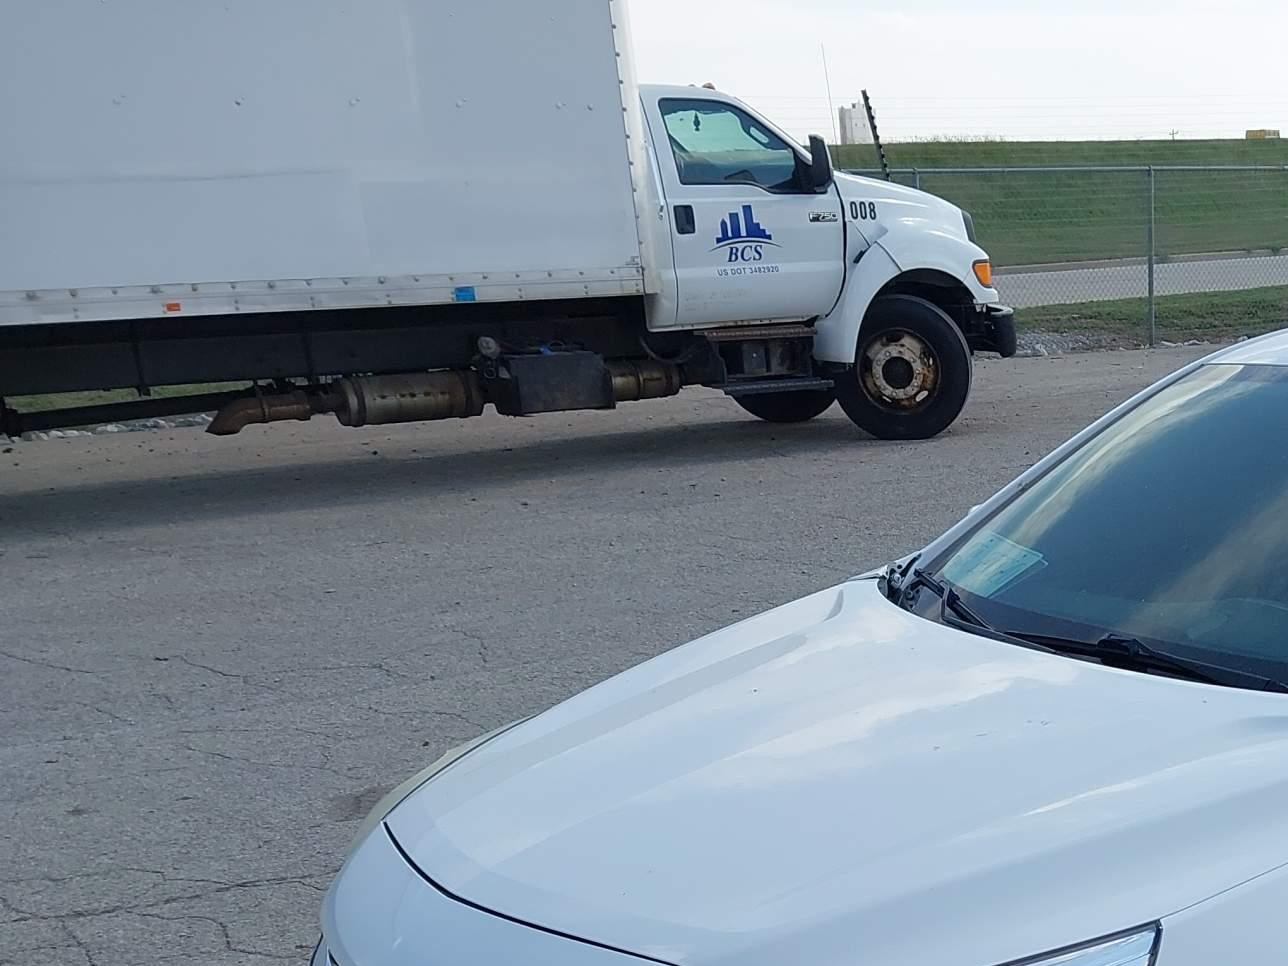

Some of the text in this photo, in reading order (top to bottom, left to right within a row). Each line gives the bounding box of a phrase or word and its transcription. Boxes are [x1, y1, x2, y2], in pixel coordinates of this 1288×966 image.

[850, 201, 877, 220] 008
[728, 244, 763, 263] BCS
[717, 268, 729, 276] US
[731, 267, 747, 275] DOT
